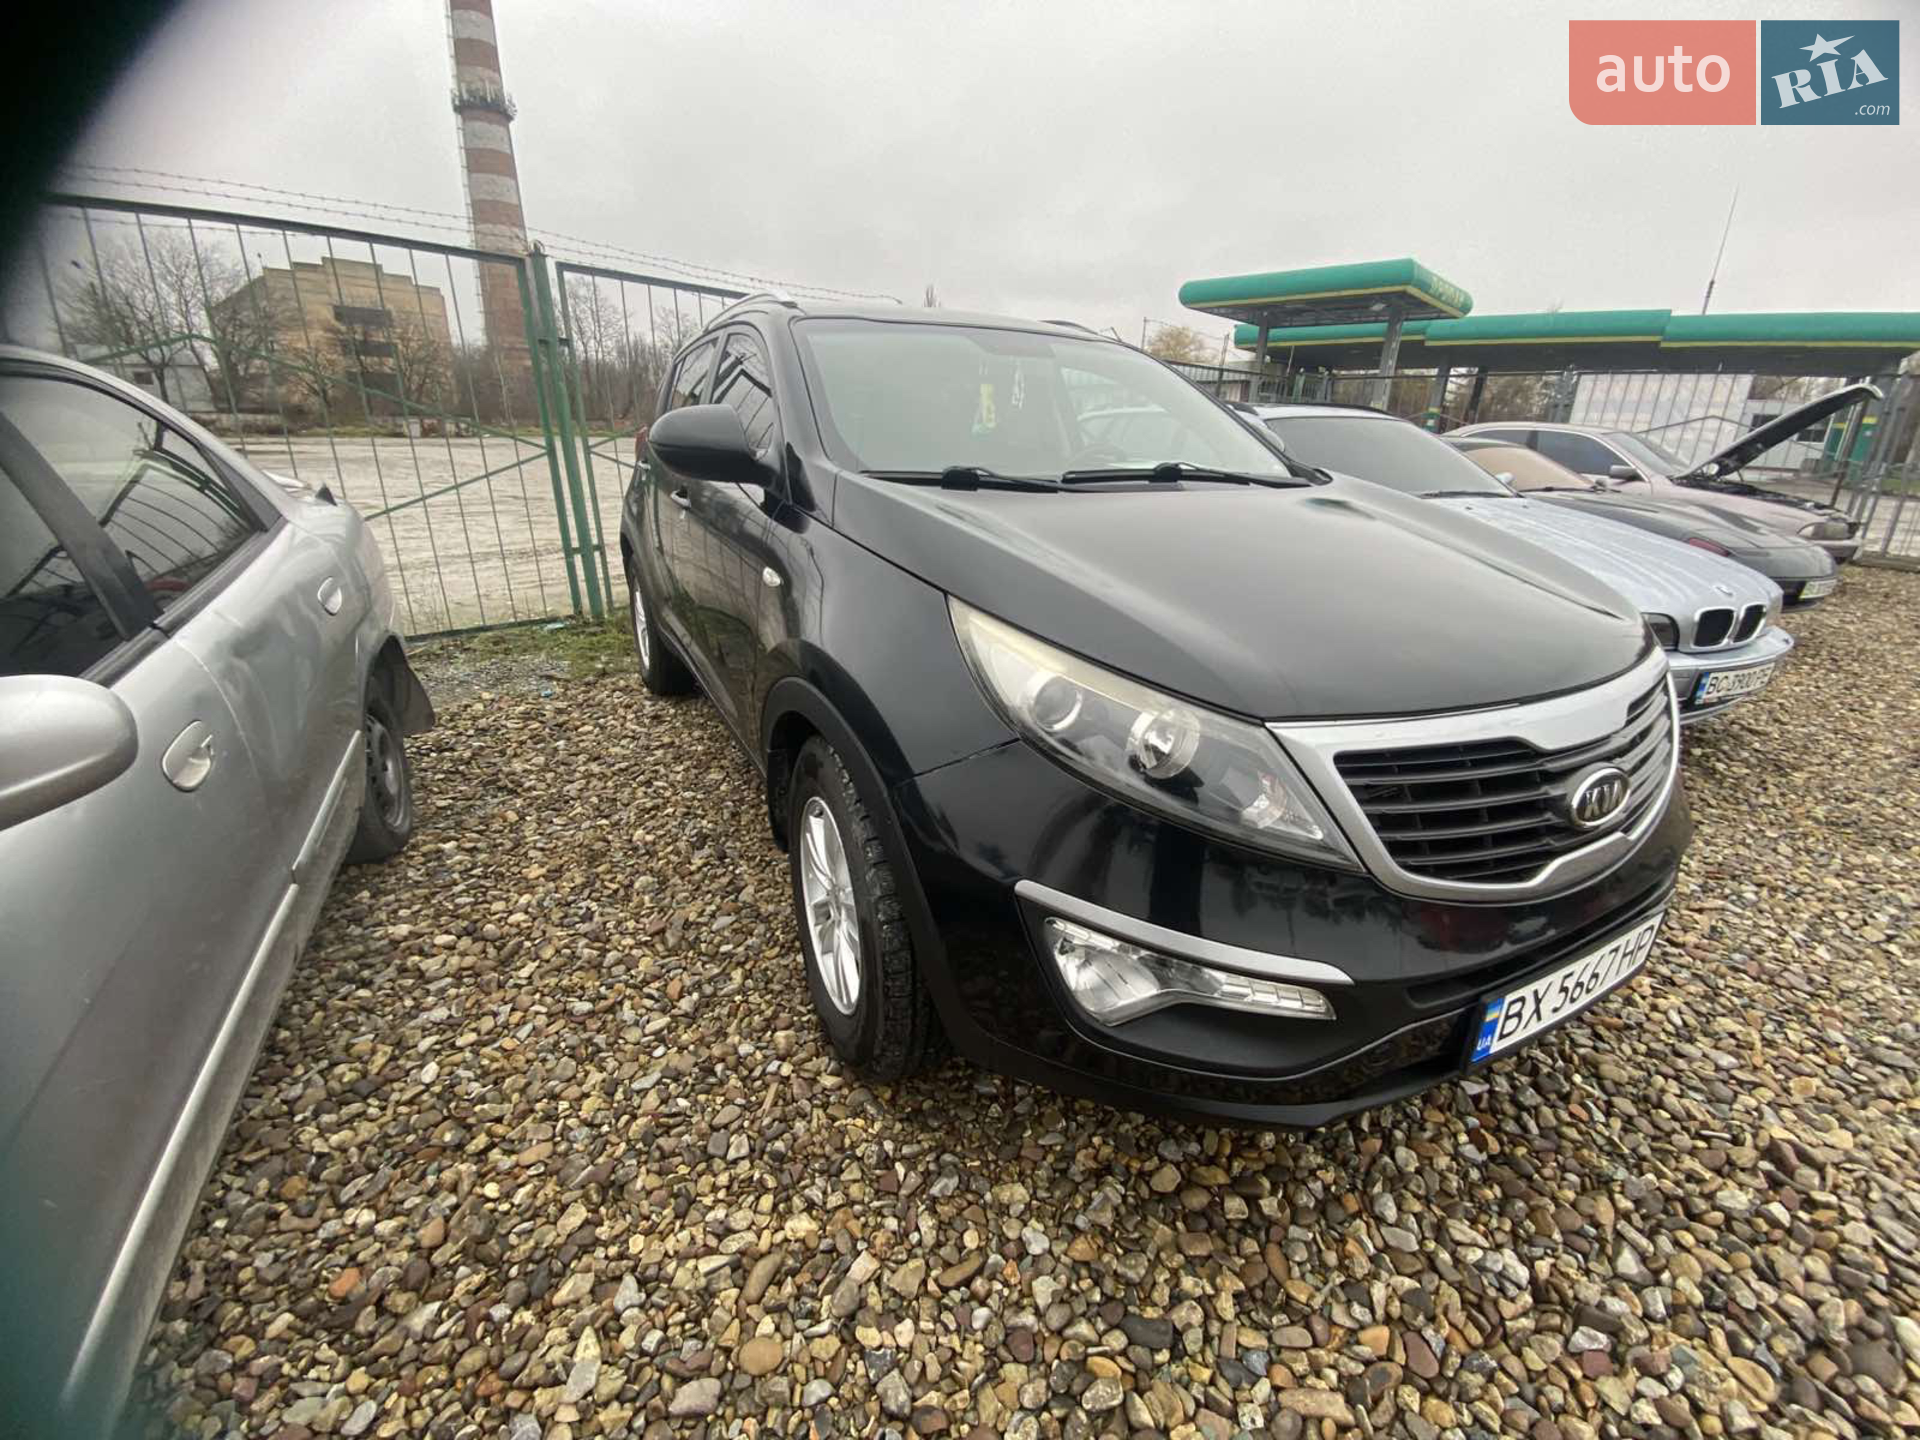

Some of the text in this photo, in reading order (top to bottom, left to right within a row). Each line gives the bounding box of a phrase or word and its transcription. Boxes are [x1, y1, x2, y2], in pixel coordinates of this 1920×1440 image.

[1583, 779, 1622, 820] KIA
[1497, 981, 1553, 1042] BX
[1551, 944, 1618, 1014] 5667
